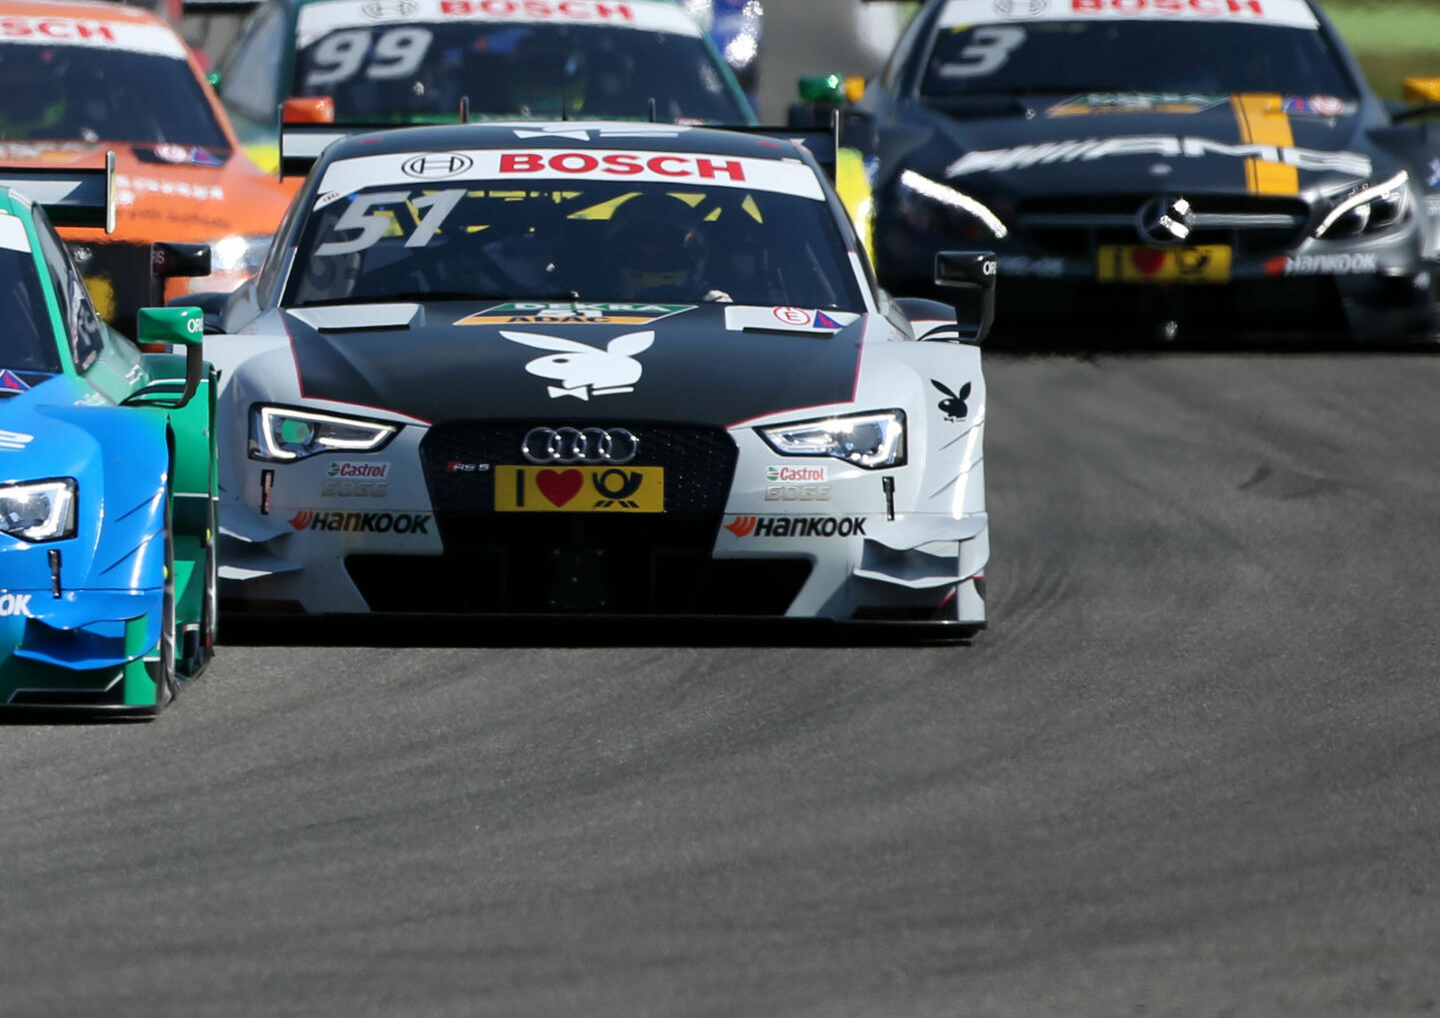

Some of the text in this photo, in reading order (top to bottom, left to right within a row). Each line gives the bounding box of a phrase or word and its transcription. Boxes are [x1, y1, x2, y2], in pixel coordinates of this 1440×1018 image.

[306, 27, 434, 83] 99
[938, 27, 1029, 78] 3
[498, 152, 746, 182] BOSCH
[314, 188, 468, 257] 51
[514, 302, 672, 312] DEKRA
[339, 463, 388, 479] Castrol
[778, 466, 826, 482] Castrol
[322, 483, 389, 498] EDGE
[516, 469, 525, 507] I
[764, 485, 833, 501] EDGE
